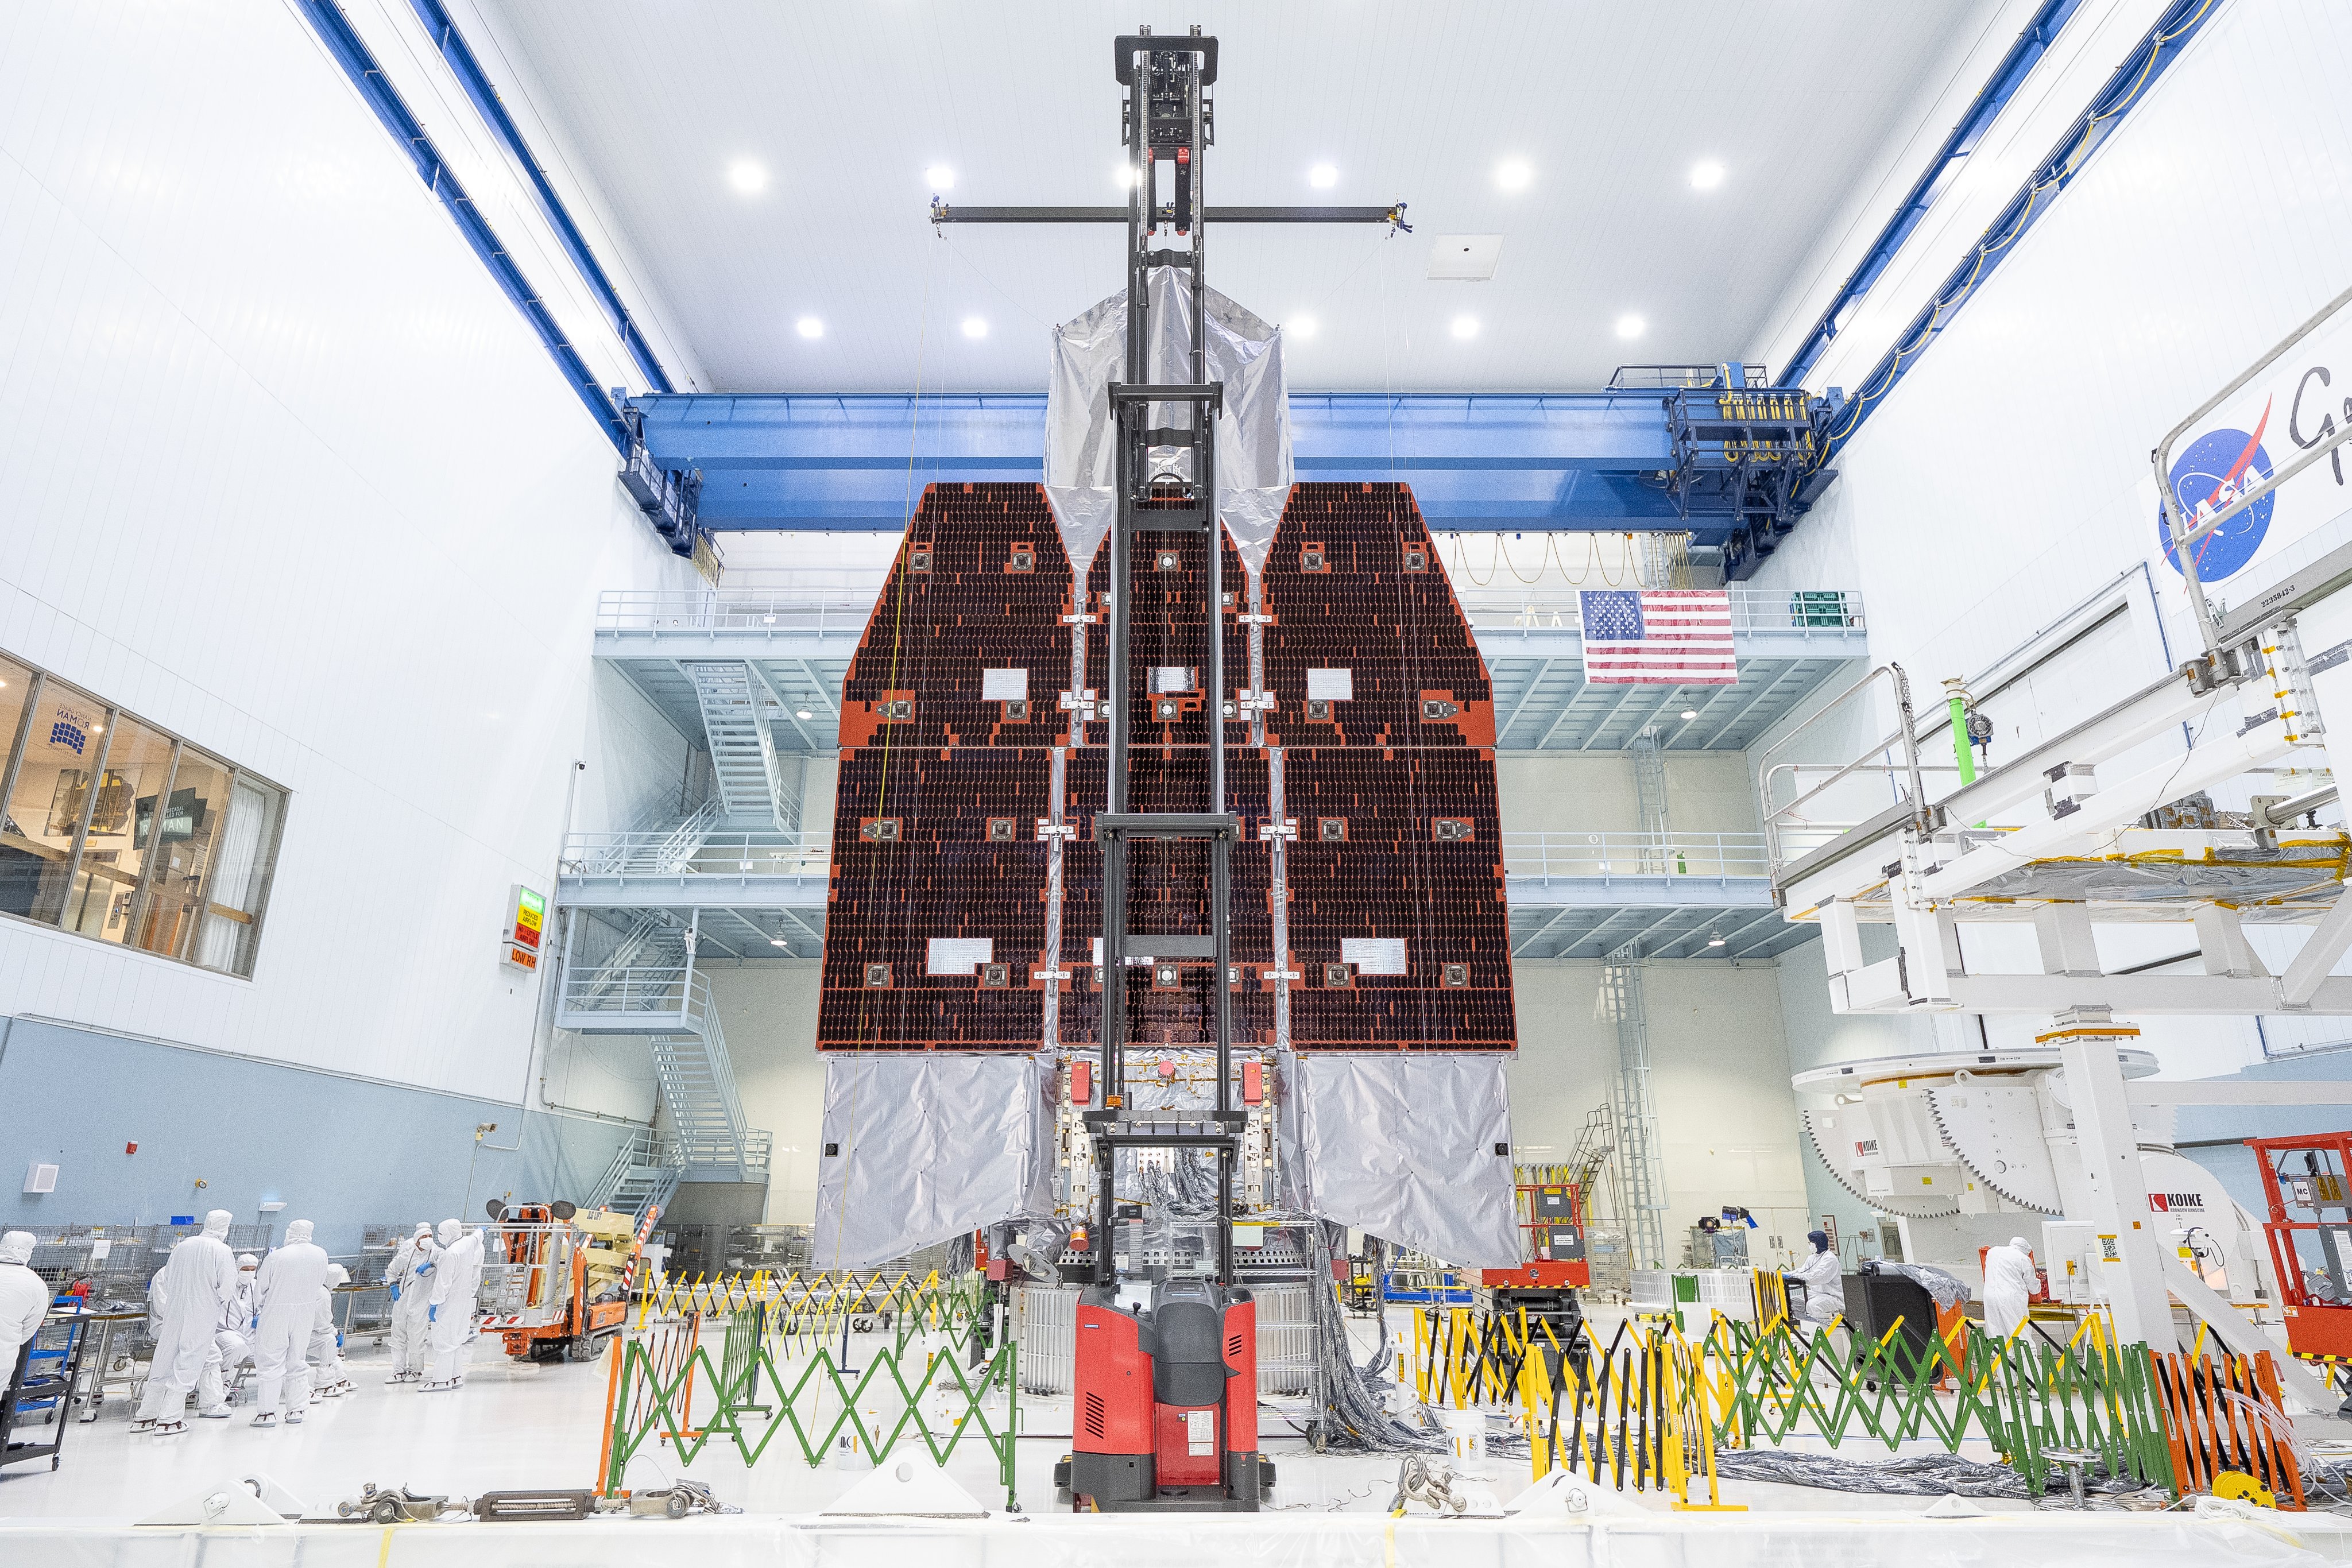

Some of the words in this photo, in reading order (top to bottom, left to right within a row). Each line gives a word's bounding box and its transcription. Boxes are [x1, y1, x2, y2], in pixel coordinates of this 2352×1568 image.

[2261, 584, 2296, 608] 2235842-3
[523, 909, 539, 921] REDUCED
[523, 916, 537, 927] AIRFLOW
[519, 935, 535, 946] AIRFLOW
[527, 929, 539, 940] LITTLE
[512, 948, 525, 964] LOW
[527, 955, 537, 969] RH
[1862, 1140, 1878, 1152] KOIKE
[2167, 1193, 2204, 1207] KOIKE
